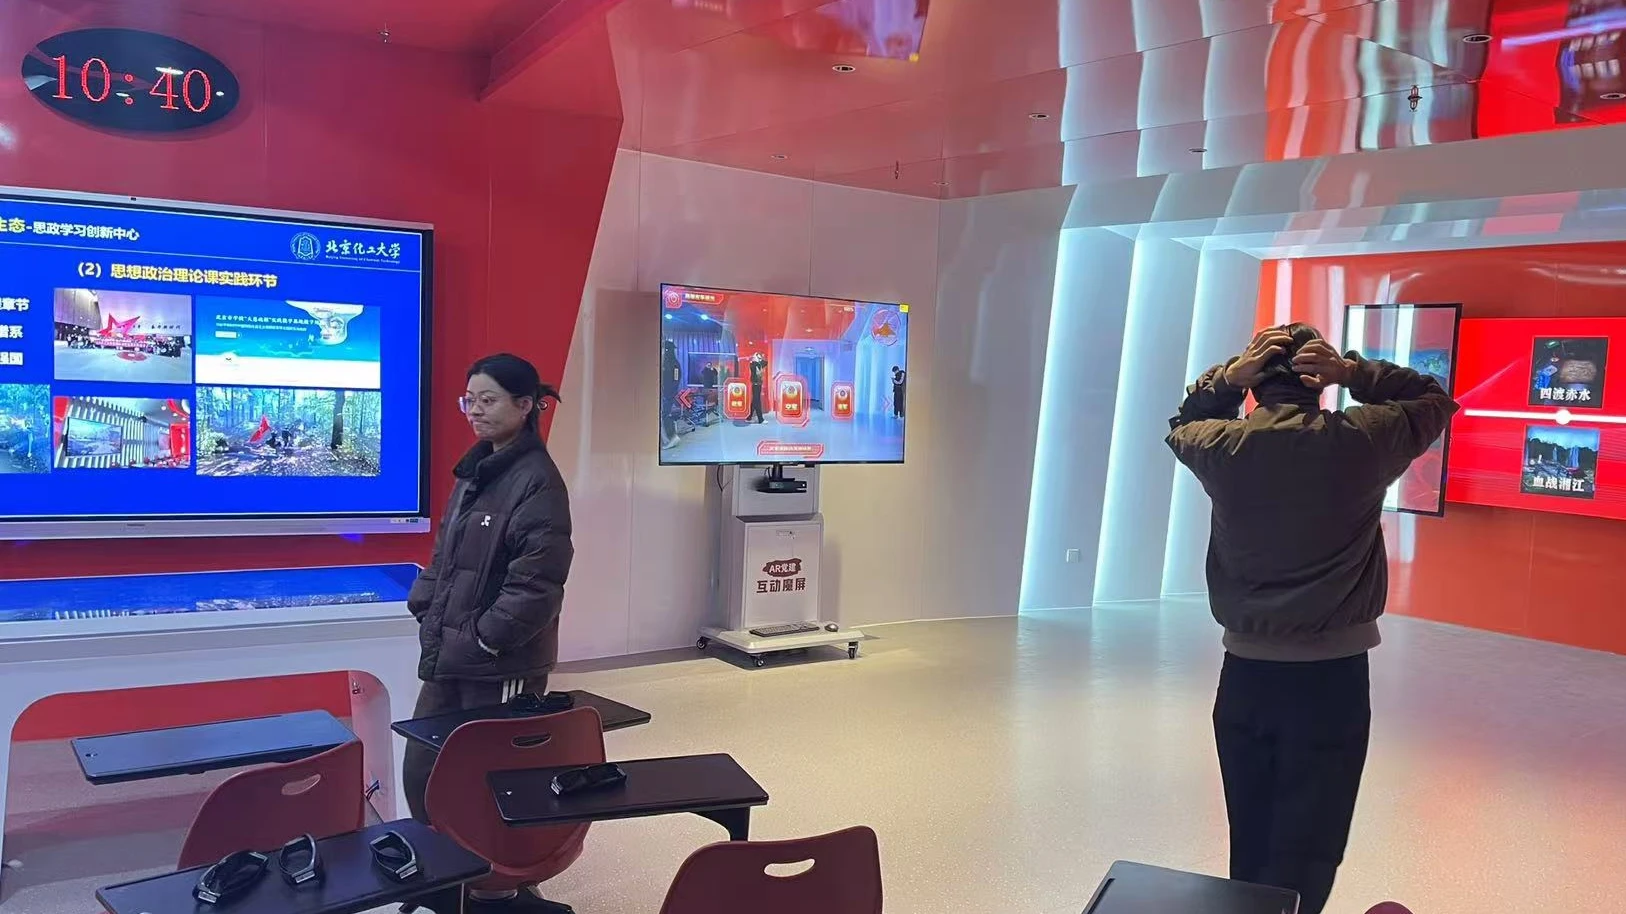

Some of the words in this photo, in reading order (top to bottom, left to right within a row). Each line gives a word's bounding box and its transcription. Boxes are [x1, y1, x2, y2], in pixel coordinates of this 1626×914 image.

[52, 55, 211, 112] 10:40
[325, 239, 400, 259] 北京化工大学
[0, 297, 30, 311] 章节
[1540, 387, 1591, 401] 四渡赤水
[1533, 475, 1585, 491] 血战湘江
[769, 562, 797, 573] AR党建
[756, 577, 806, 593] 互动魔屏
